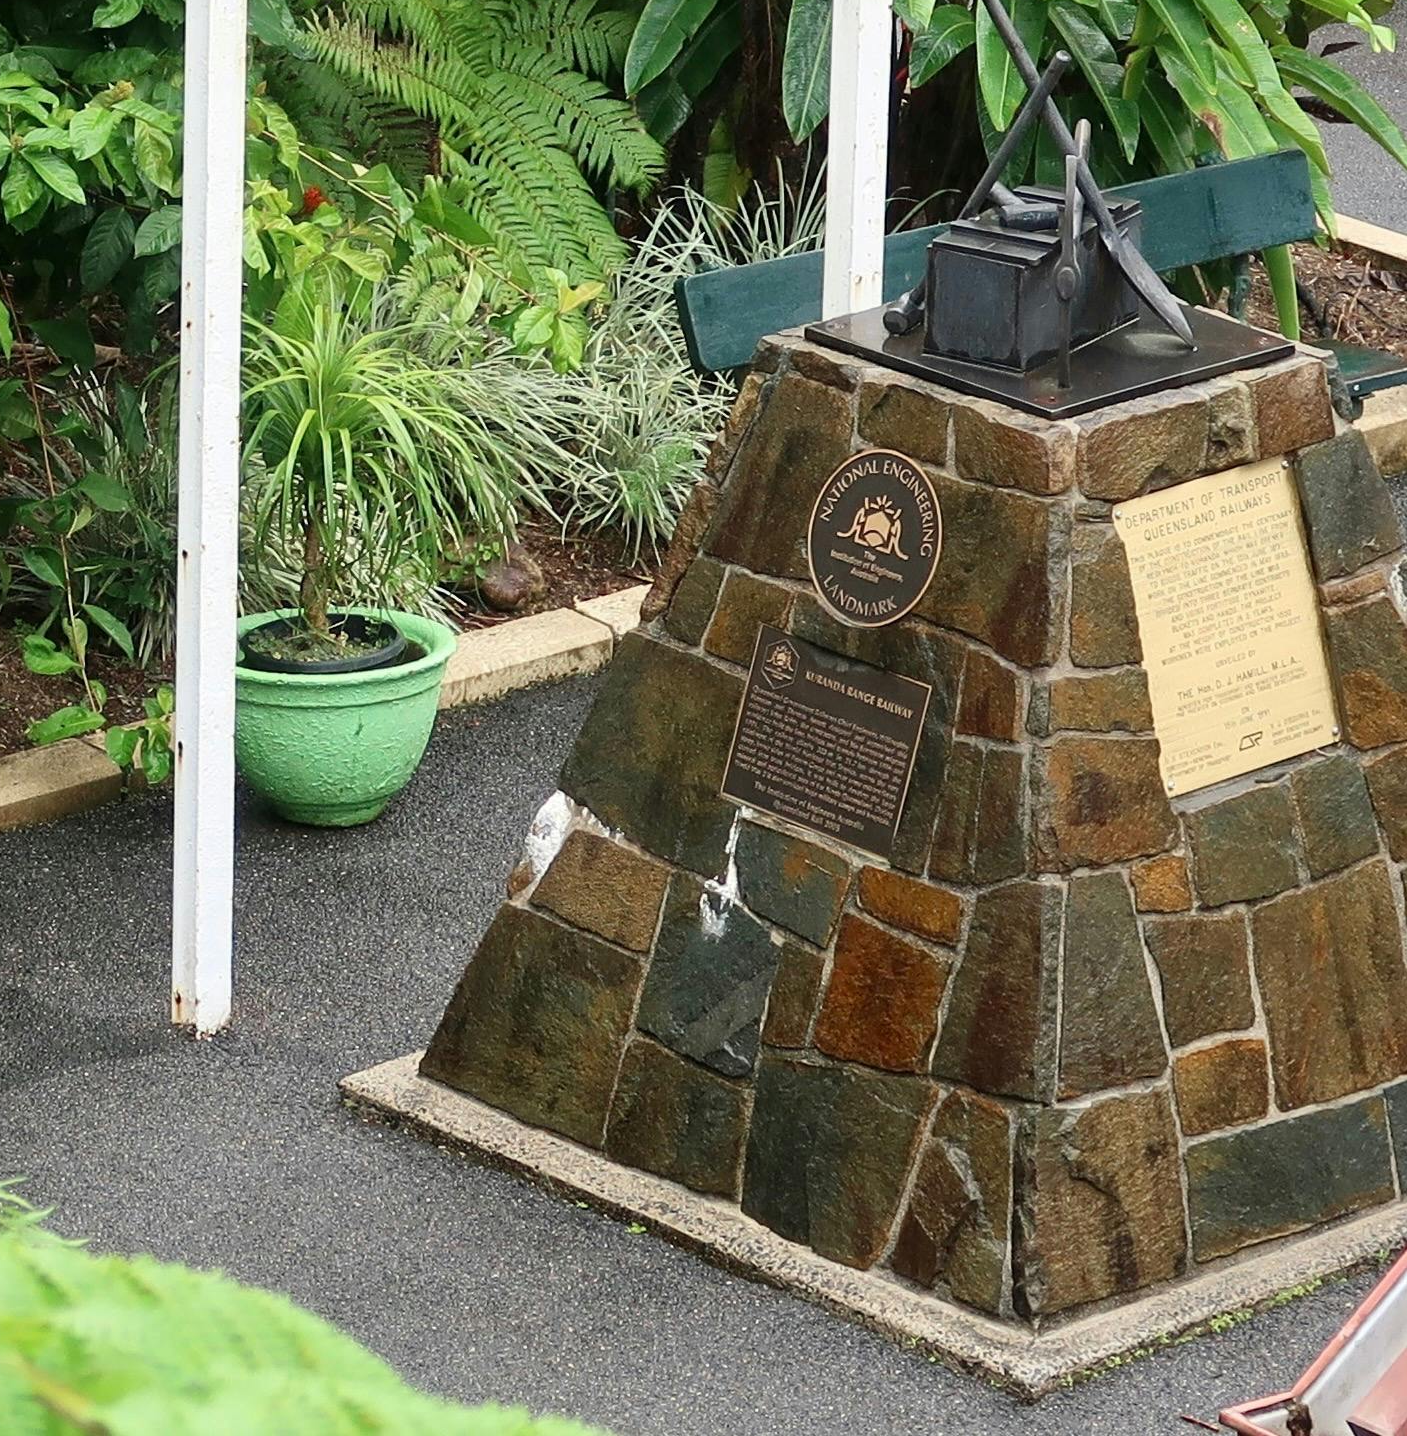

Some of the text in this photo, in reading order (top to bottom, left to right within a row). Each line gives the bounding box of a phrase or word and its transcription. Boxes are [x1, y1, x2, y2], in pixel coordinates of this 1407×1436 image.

[820, 460, 933, 558] NATIONAL ENGINEERING
[1124, 470, 1282, 529] DEPARTMENT OF TRANSPORT
[1143, 492, 1271, 542] QUEENSLAND RAILWAYS
[823, 575, 897, 617] LANDMARK
[804, 669, 846, 694] KURANDA
[845, 686, 876, 705] RANGE
[875, 697, 914, 720] RAILWAY
[1176, 687, 1193, 702] THE
